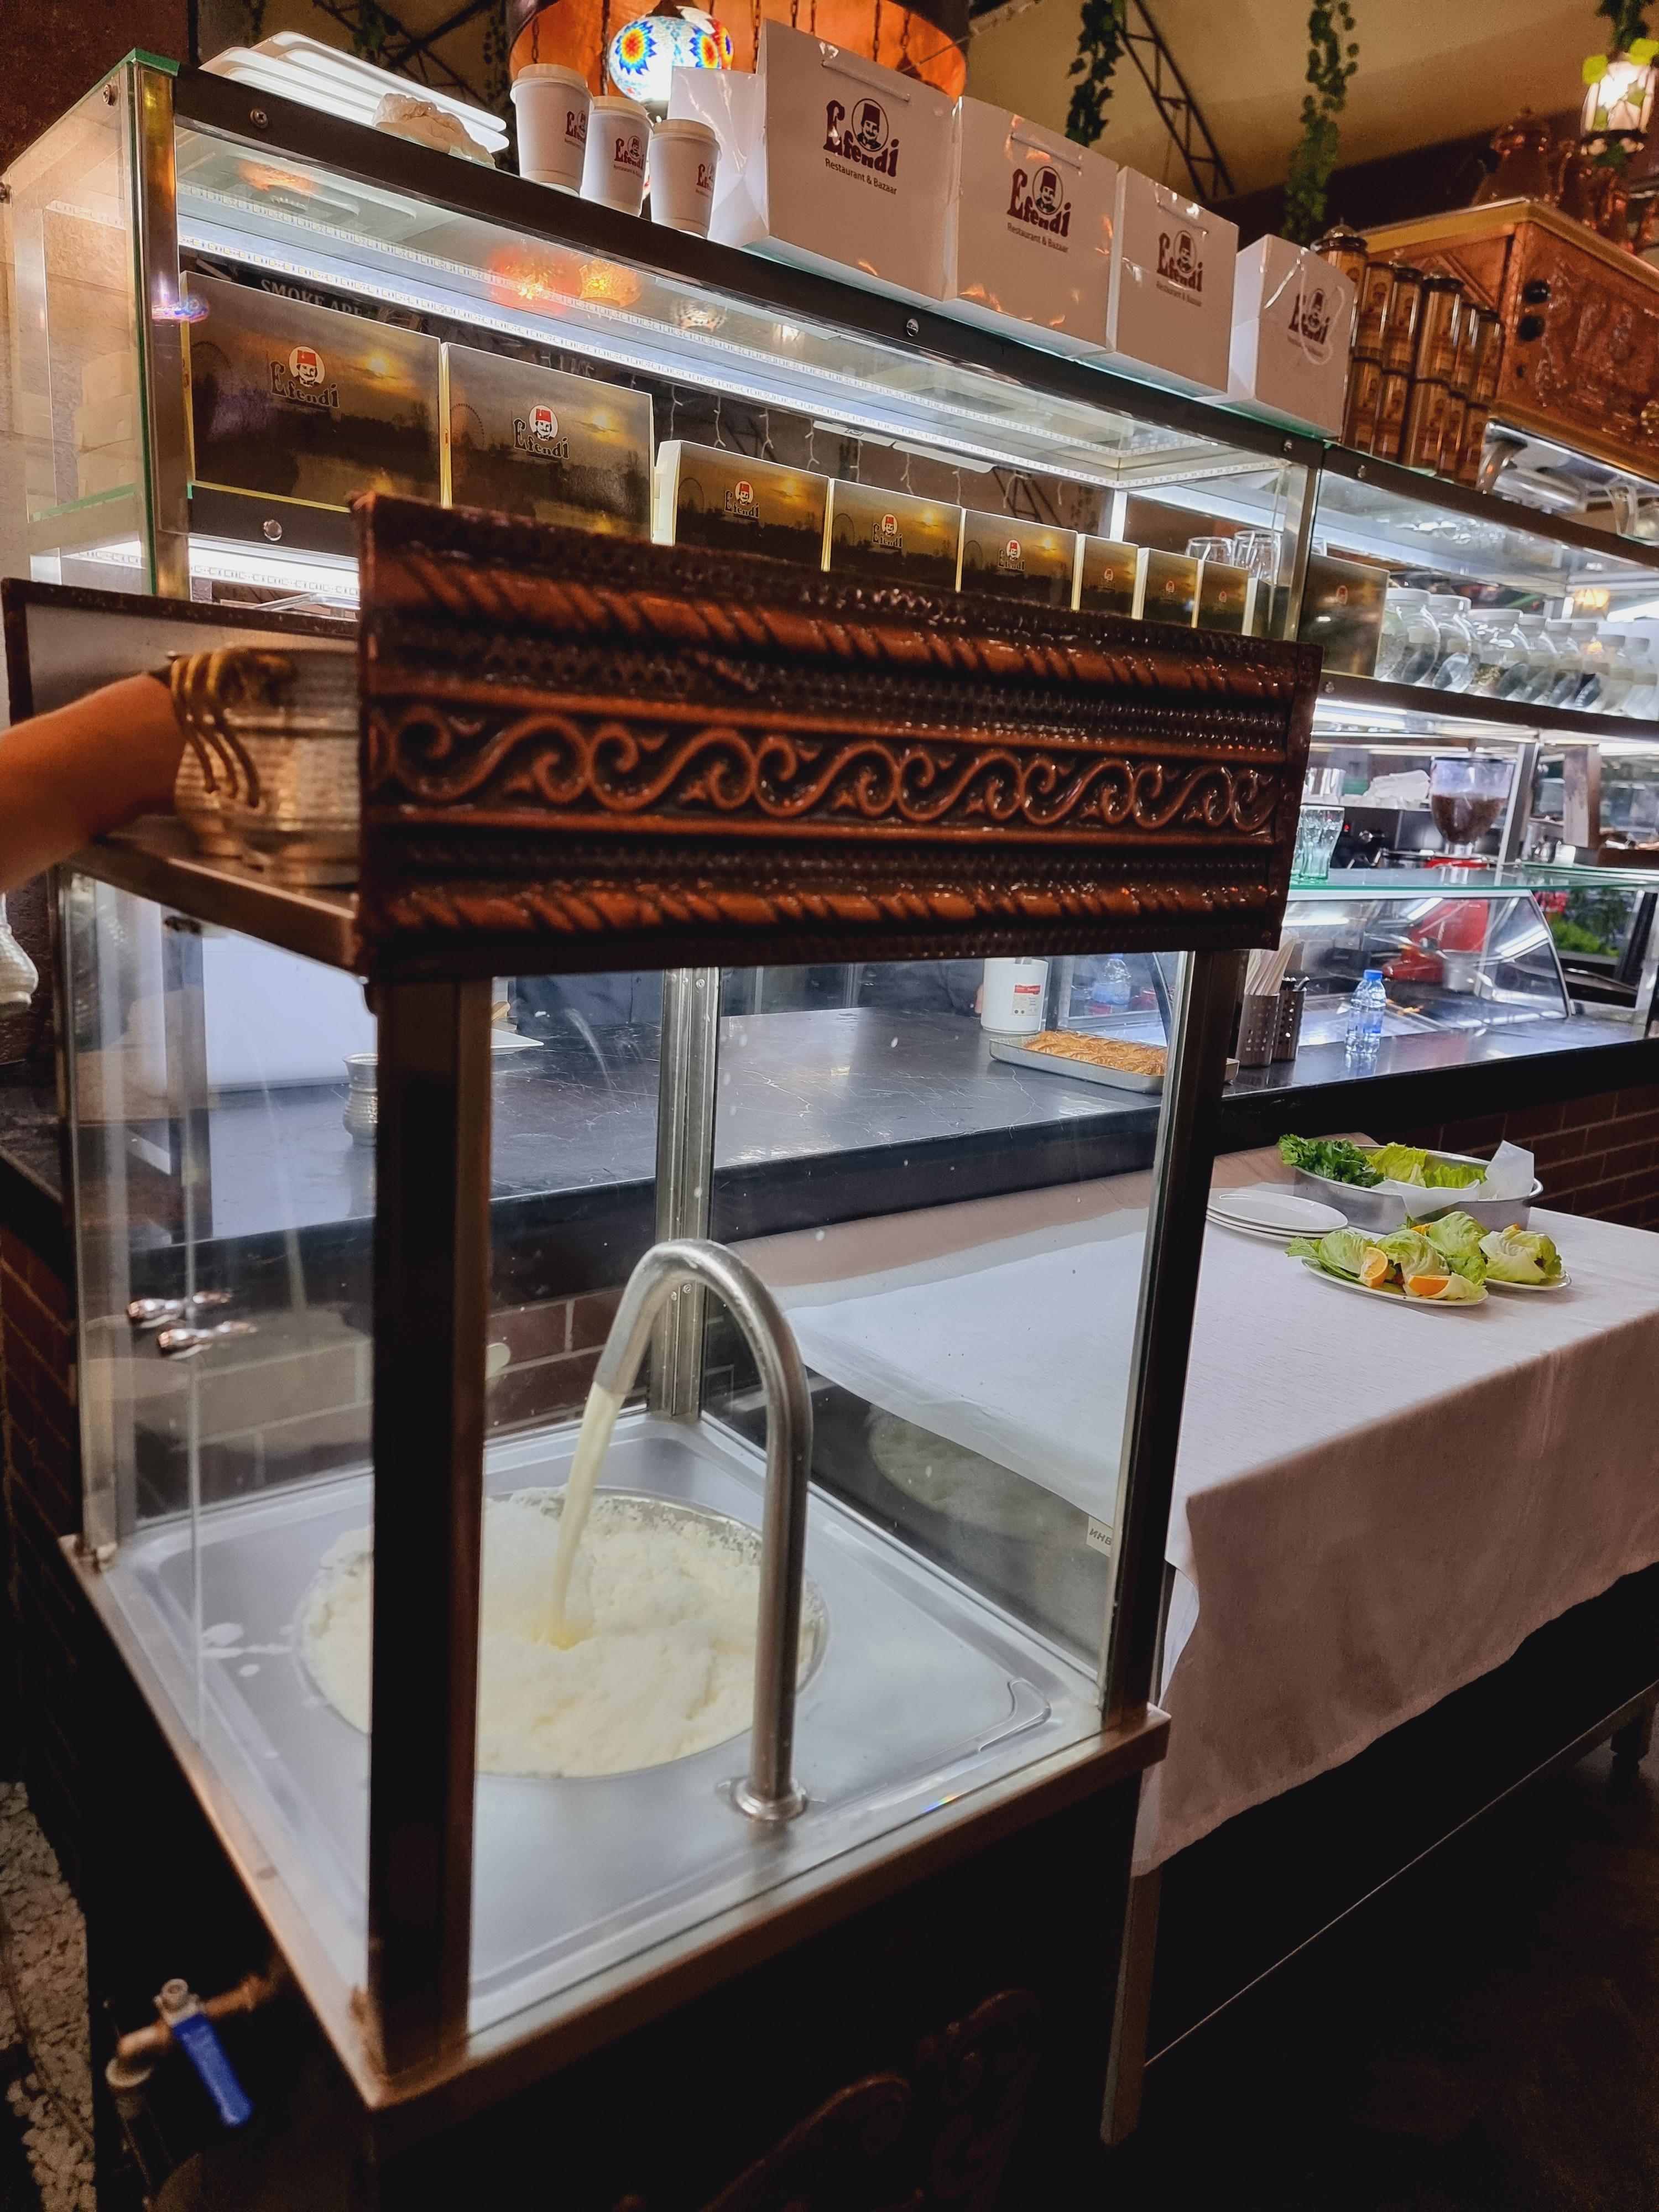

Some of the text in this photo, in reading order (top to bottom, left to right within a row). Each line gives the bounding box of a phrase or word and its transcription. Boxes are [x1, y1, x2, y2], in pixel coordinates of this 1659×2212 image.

[823, 100, 899, 177] Efendi
[825, 158, 898, 195] Restaurant & Bazaar
[1006, 168, 1072, 237] Efendi
[1007, 222, 1041, 244] Restaurant
[1156, 232, 1203, 293] Efendi
[270, 361, 340, 409] Efendi
[513, 418, 570, 460] Efendi
[724, 489, 760, 519] Efendi
